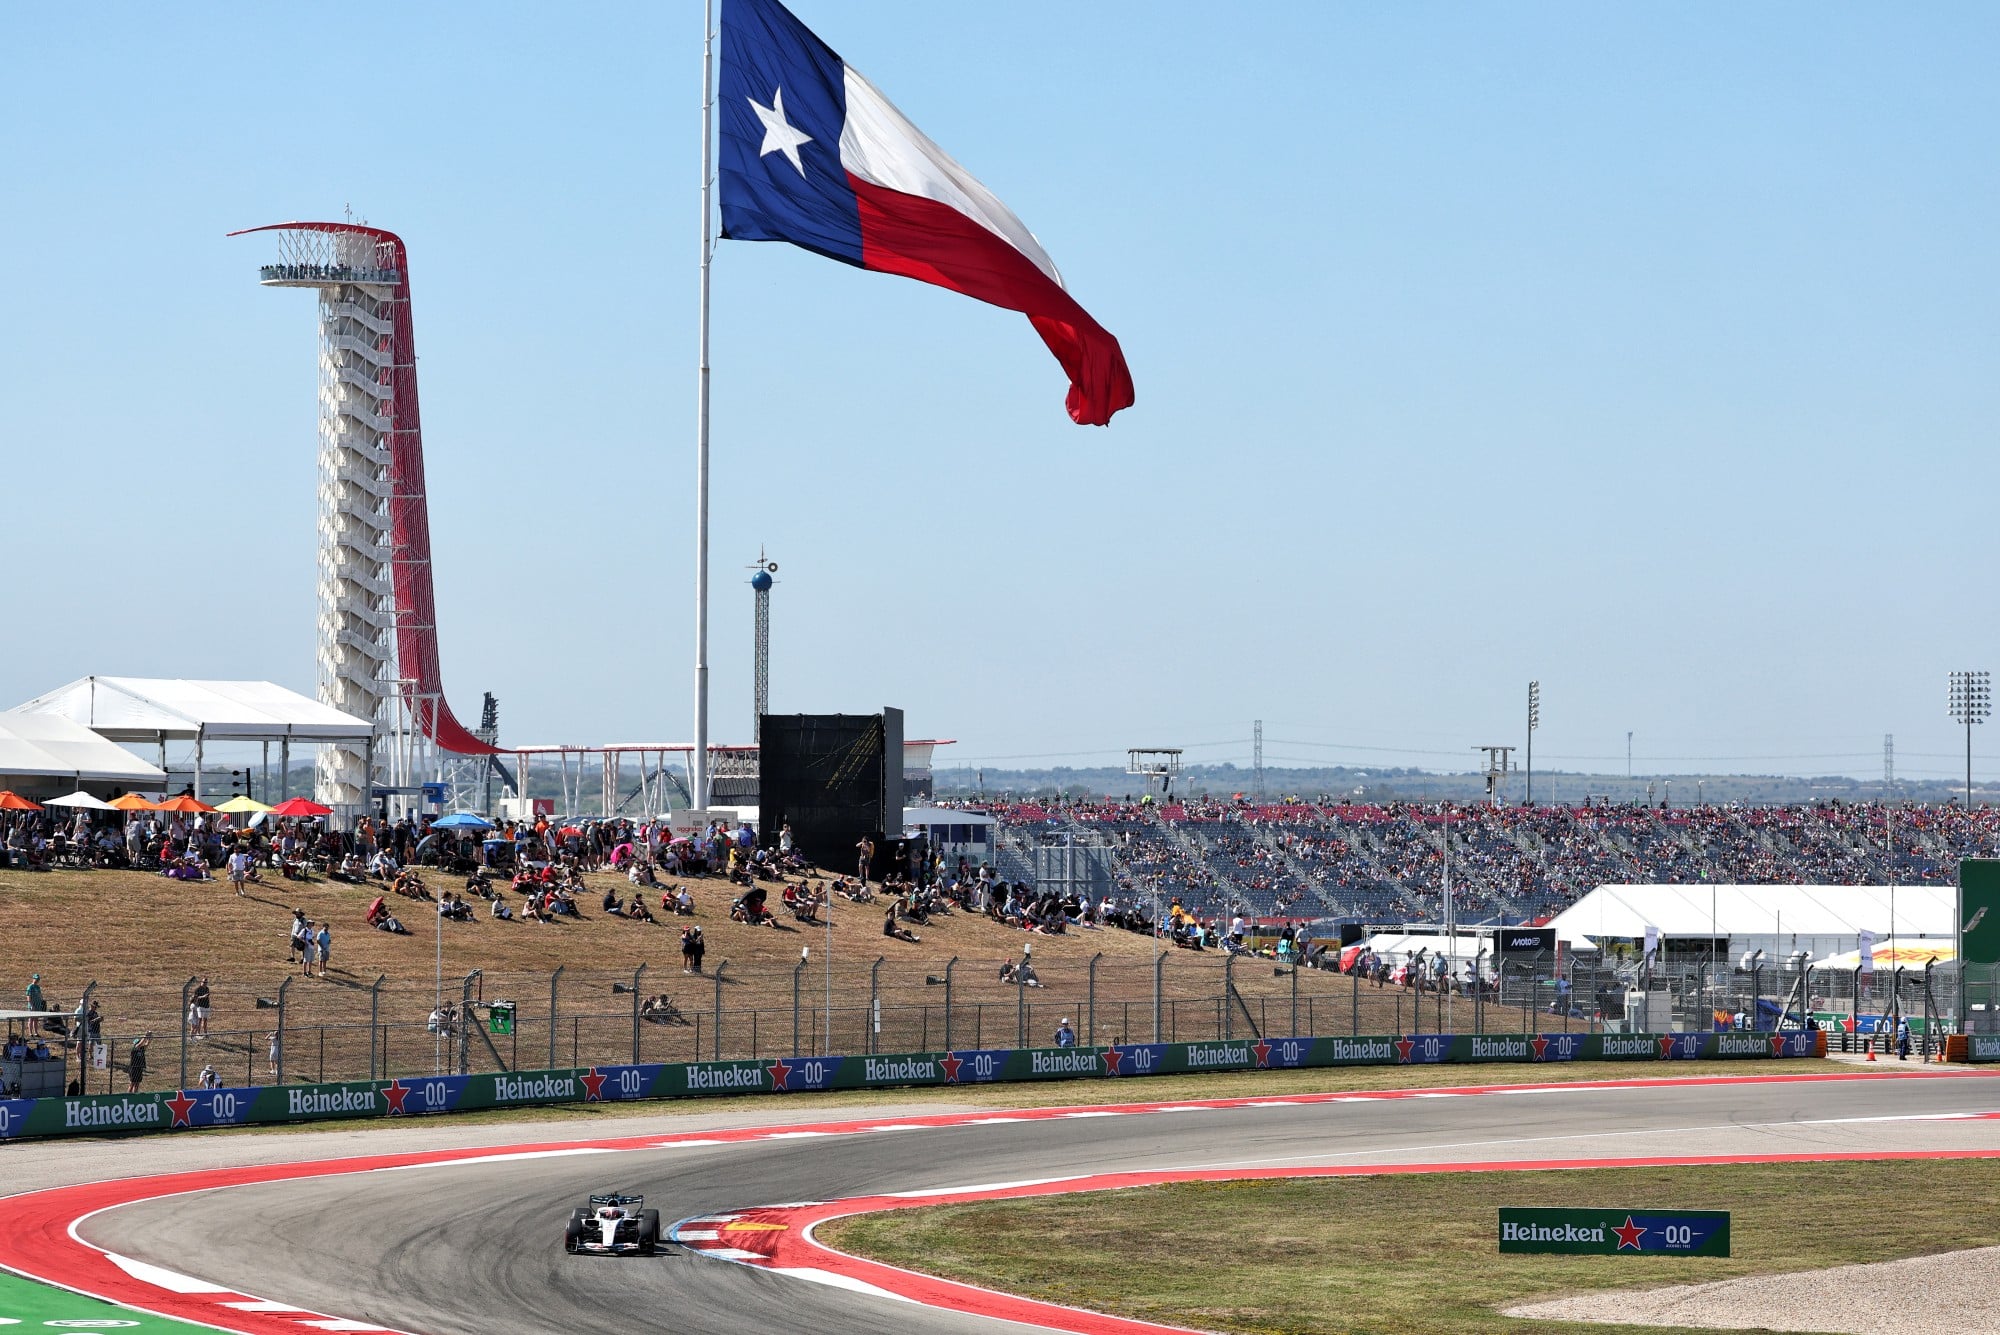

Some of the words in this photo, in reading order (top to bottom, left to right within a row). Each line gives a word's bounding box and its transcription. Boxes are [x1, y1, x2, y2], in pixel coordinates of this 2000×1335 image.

[1187, 1044, 1248, 1066] Heineken
[1333, 1038, 1391, 1060] Heineken
[1471, 1036, 1526, 1057] Heineken
[1602, 1035, 1654, 1055] Heineken
[1718, 1034, 1767, 1054] Heineken
[865, 1057, 935, 1081] Heineken
[1032, 1050, 1097, 1073] Heineken
[494, 1074, 575, 1101] Heineken
[687, 1064, 762, 1089] Heineken
[288, 1086, 376, 1114] Heineken
[66, 1100, 160, 1127] Heineken
[1502, 1222, 1605, 1242] Heineken
[1665, 1225, 1691, 1244] 0.0
